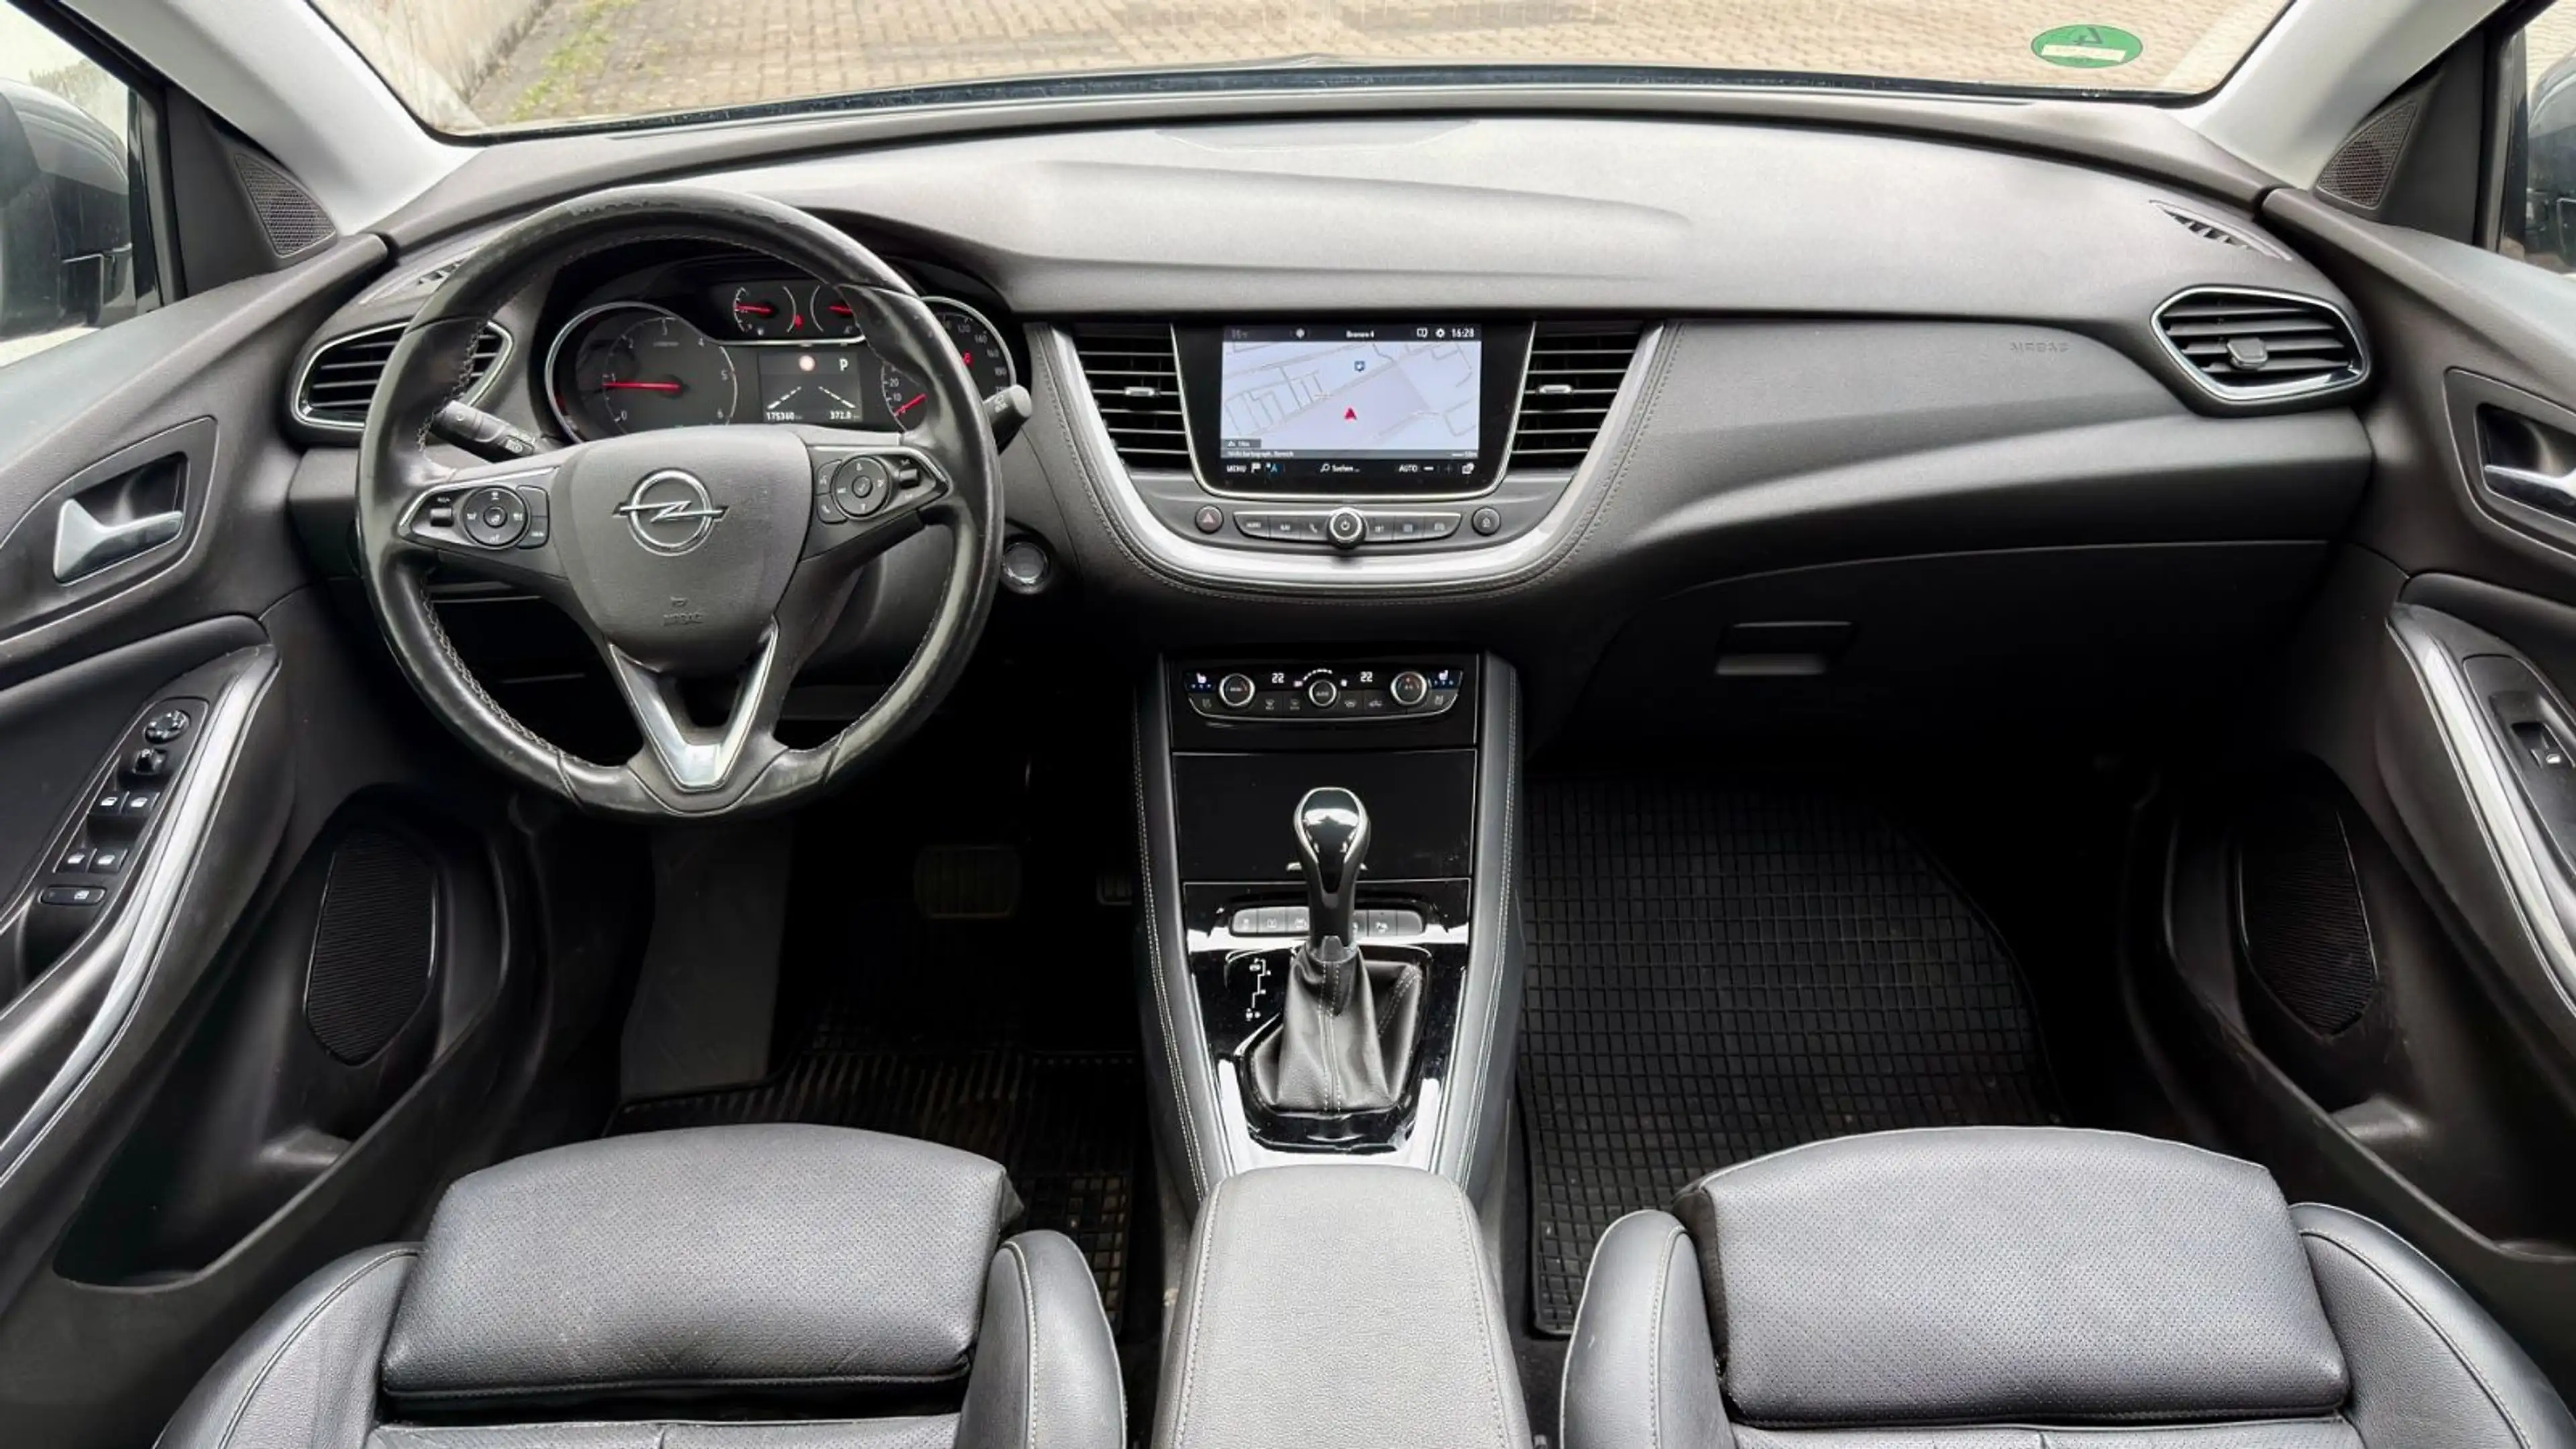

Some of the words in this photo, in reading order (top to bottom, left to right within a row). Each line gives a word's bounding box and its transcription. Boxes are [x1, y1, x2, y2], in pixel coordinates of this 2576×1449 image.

[1451, 327, 1474, 338] 16:28
[839, 358, 849, 372] P
[1399, 465, 1418, 474] AUTO
[1271, 672, 1285, 684] 22
[1360, 671, 1373, 683] 22
